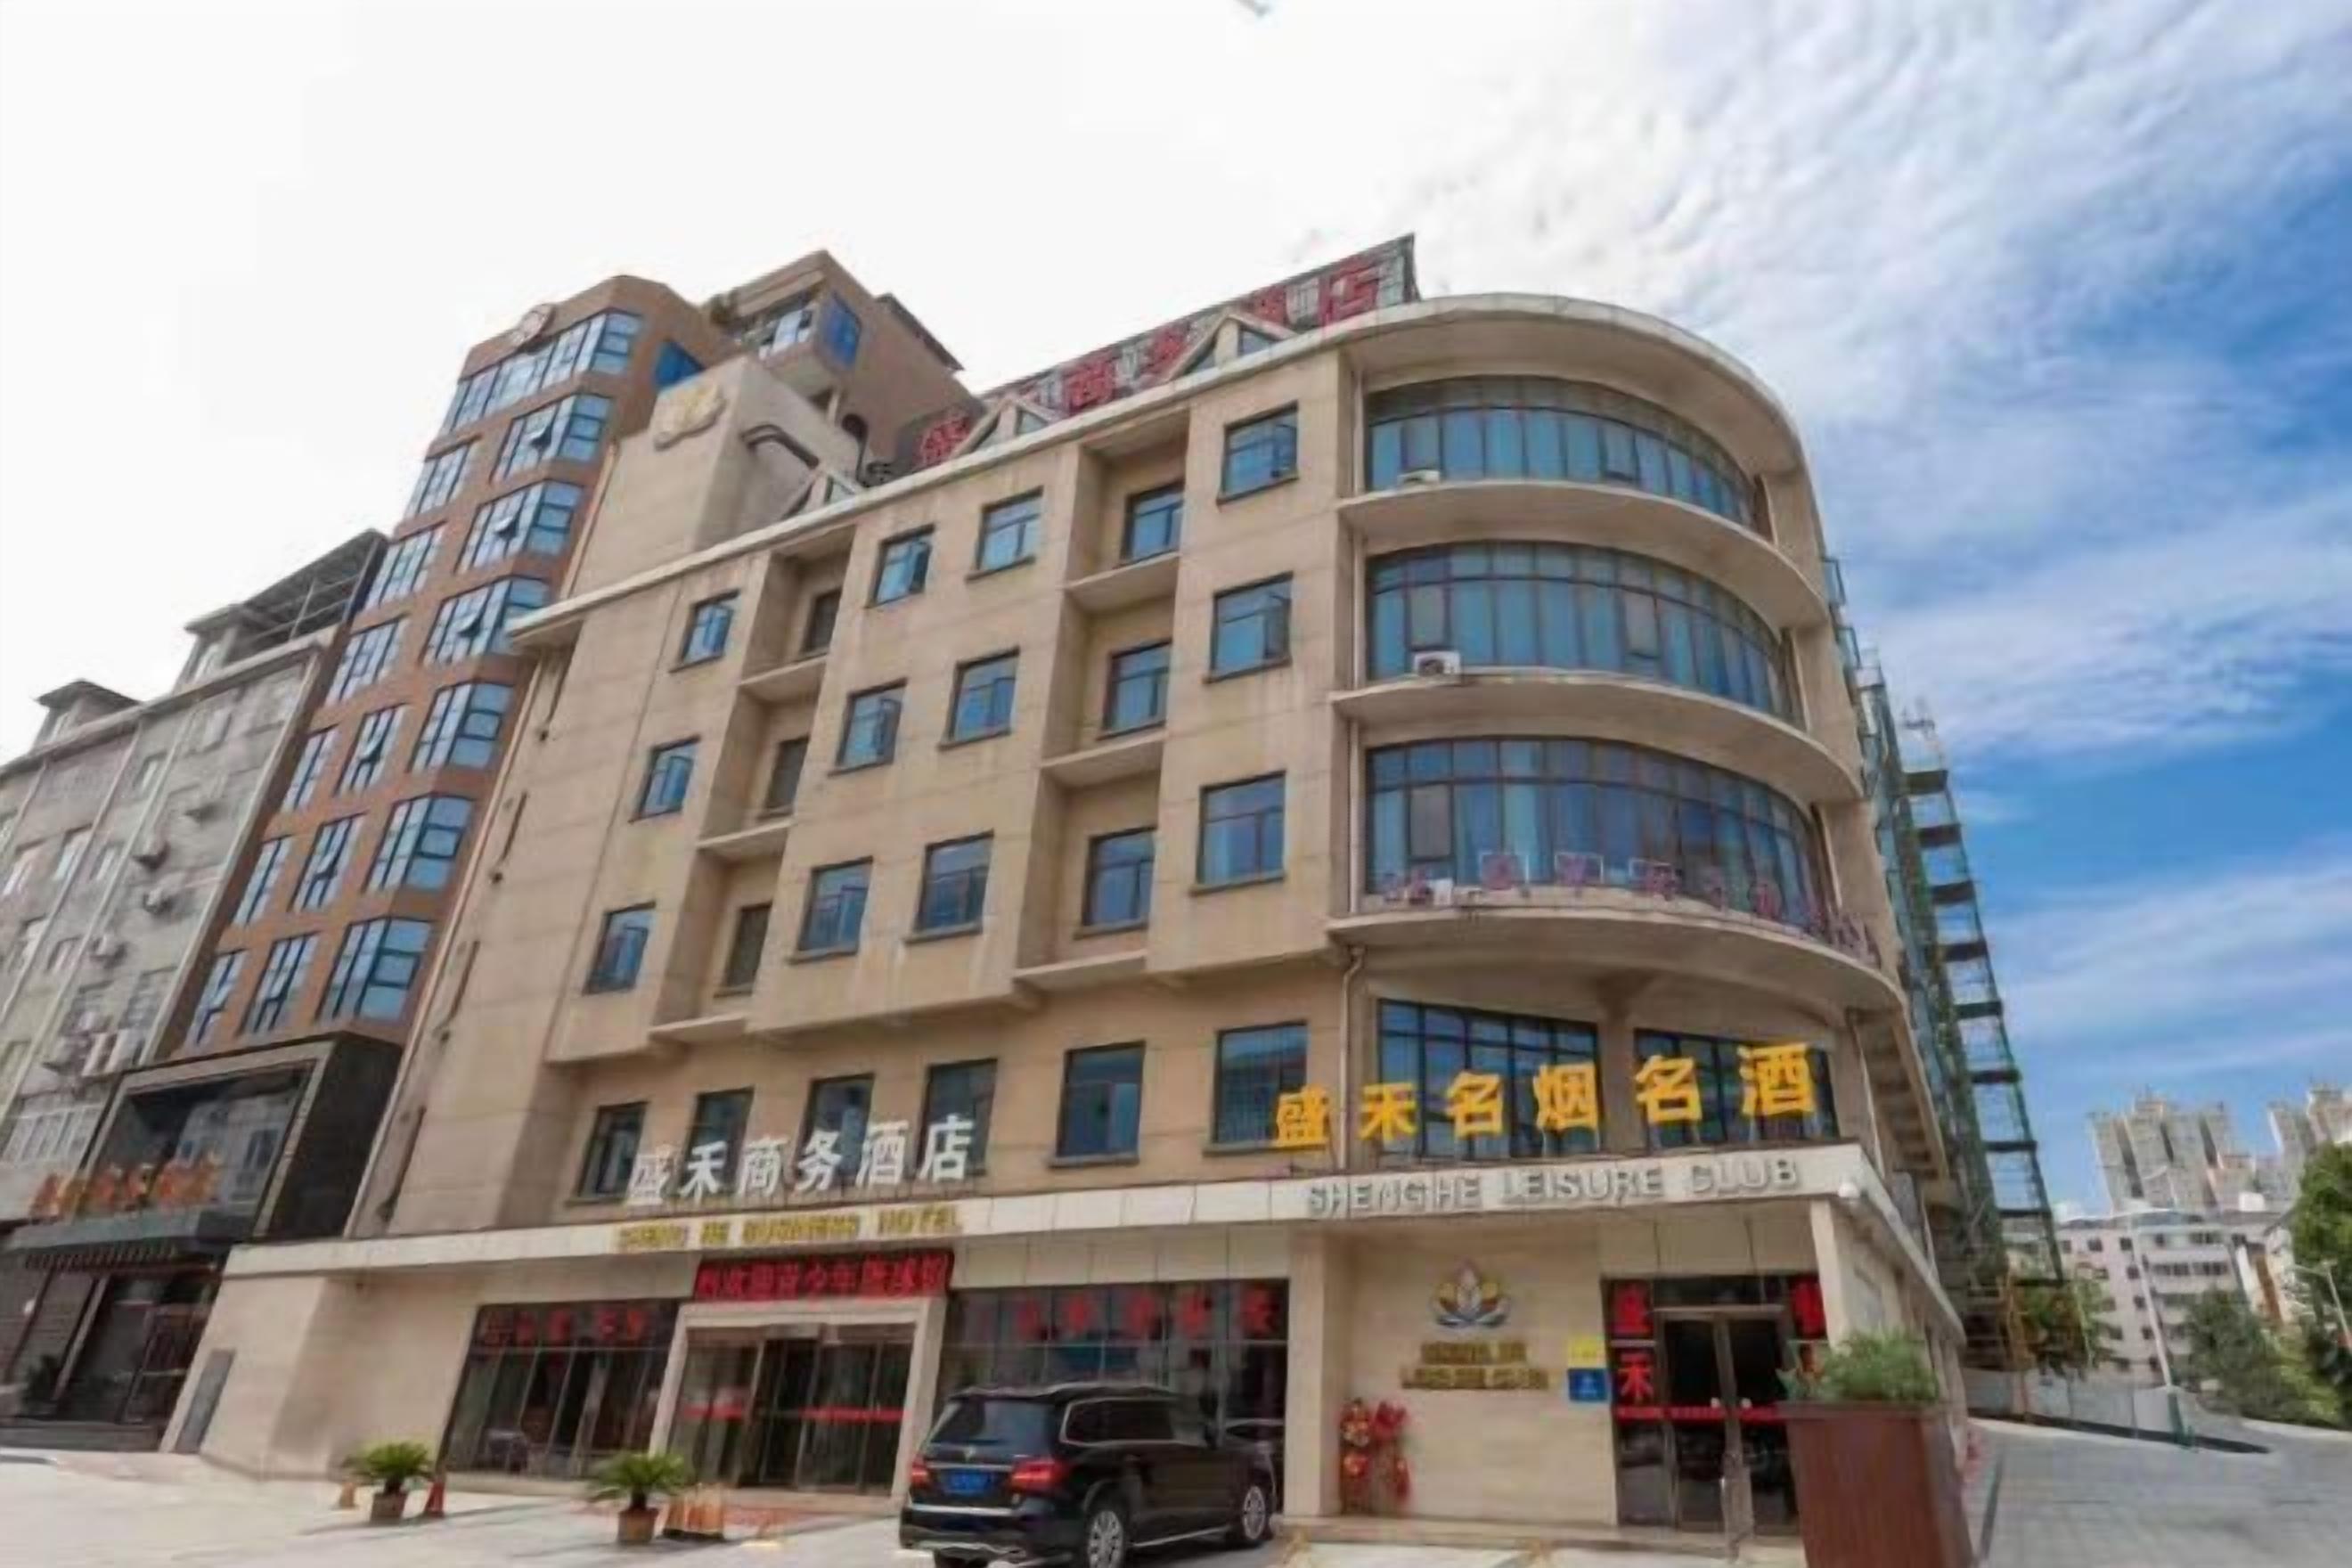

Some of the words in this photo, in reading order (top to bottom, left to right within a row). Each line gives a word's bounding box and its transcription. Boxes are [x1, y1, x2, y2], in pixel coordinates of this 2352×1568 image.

[1272, 1042, 1818, 1147] 盛禾名烟名酒
[624, 1112, 974, 1206] 盛禾商务酒店
[1502, 1165, 1665, 1203] LEISURE
[1690, 1158, 1799, 1194] CLUB
